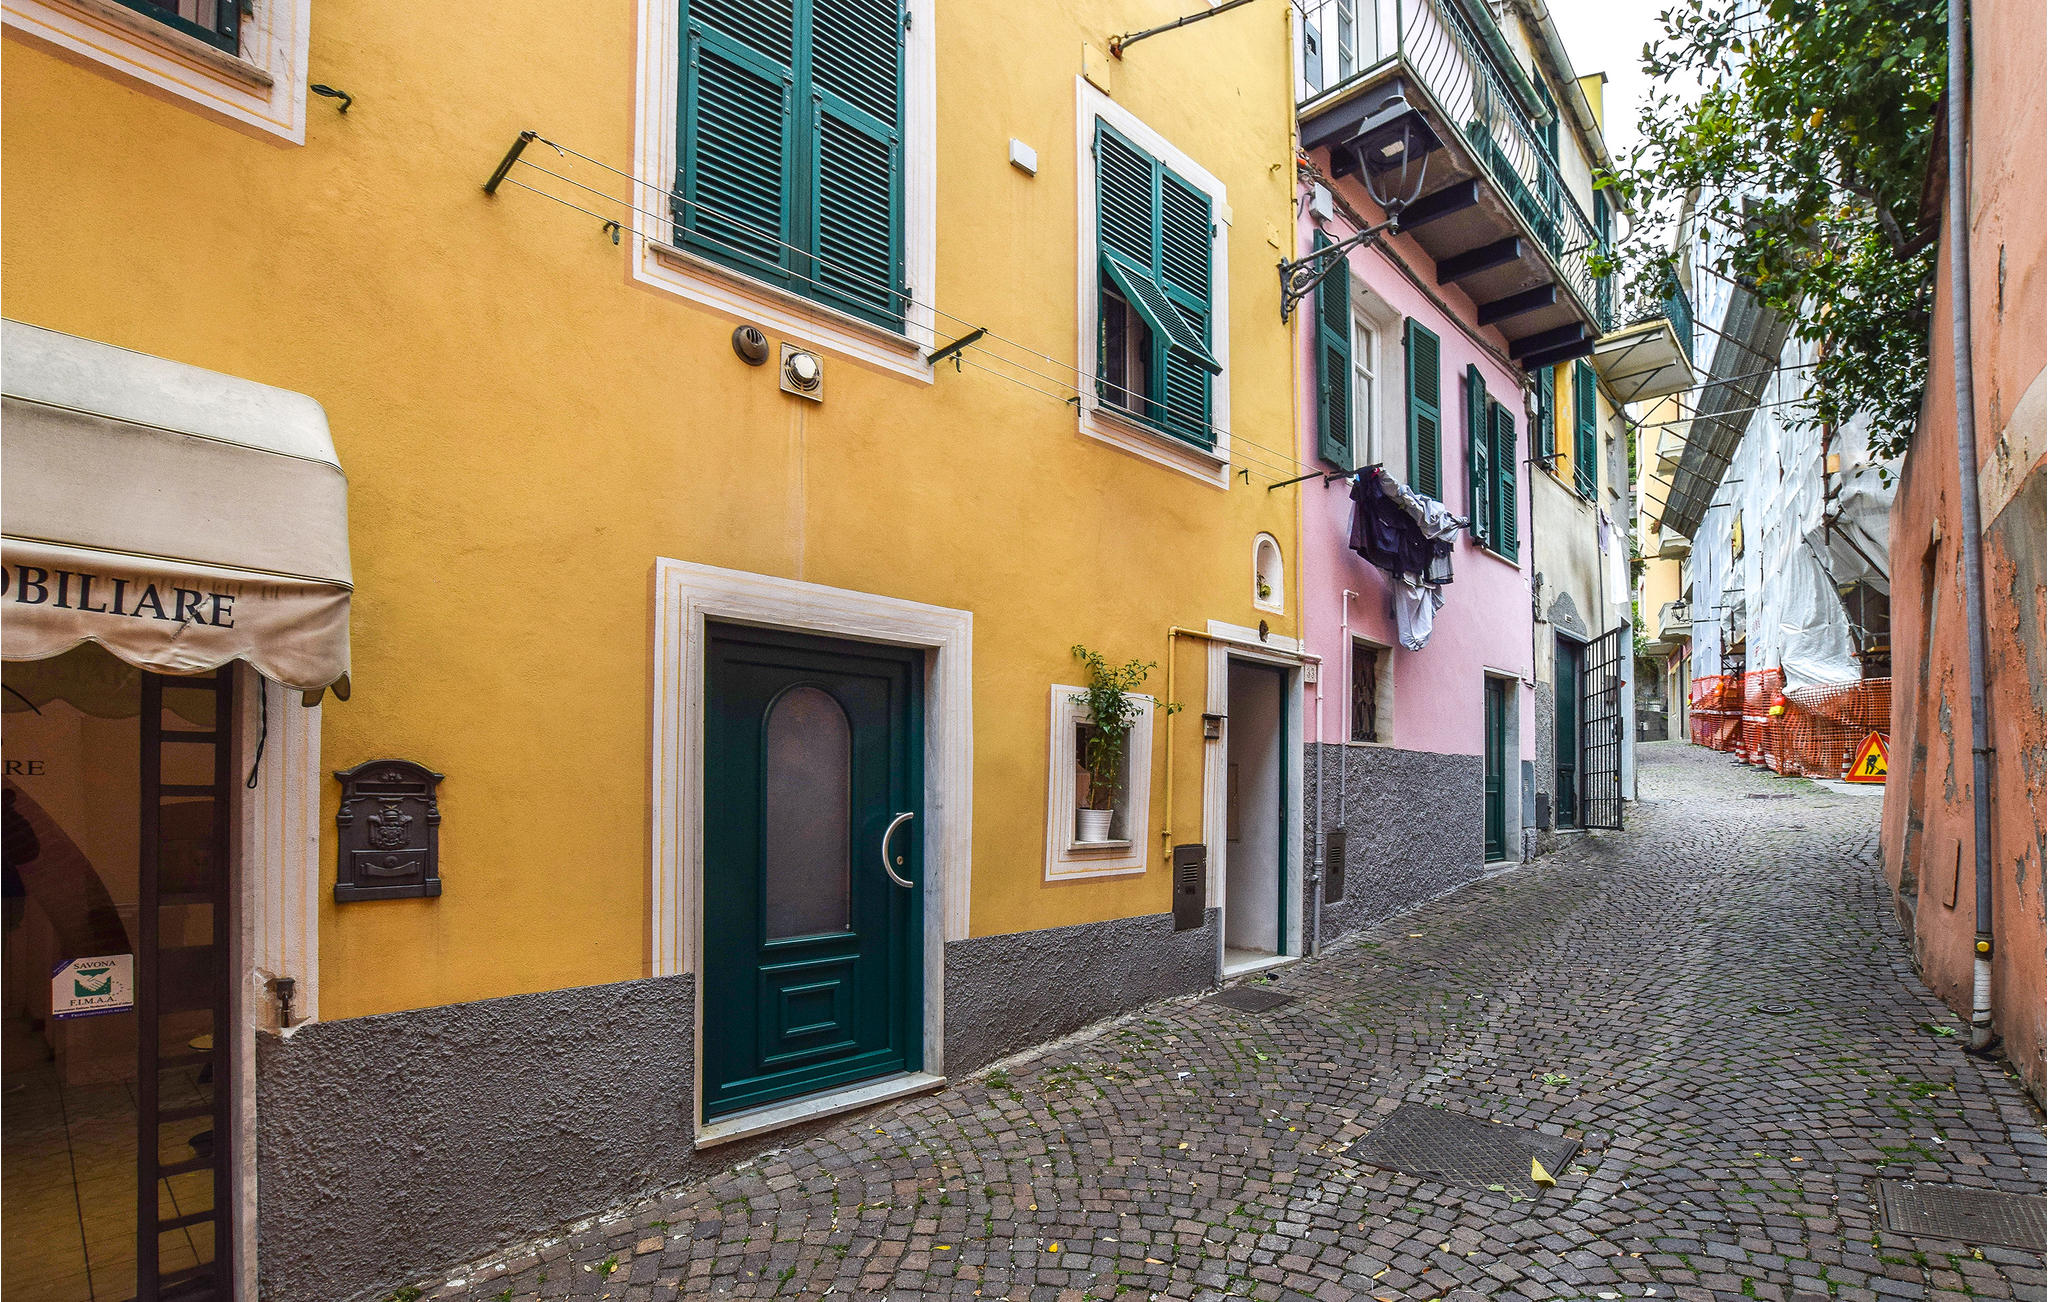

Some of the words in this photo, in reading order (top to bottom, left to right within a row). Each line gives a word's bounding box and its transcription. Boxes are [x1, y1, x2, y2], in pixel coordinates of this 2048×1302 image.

[1, 563, 235, 629] BILIARE
[73, 960, 116, 970] SAVONA
[70, 996, 117, 1007] F.I.M.A.A.
